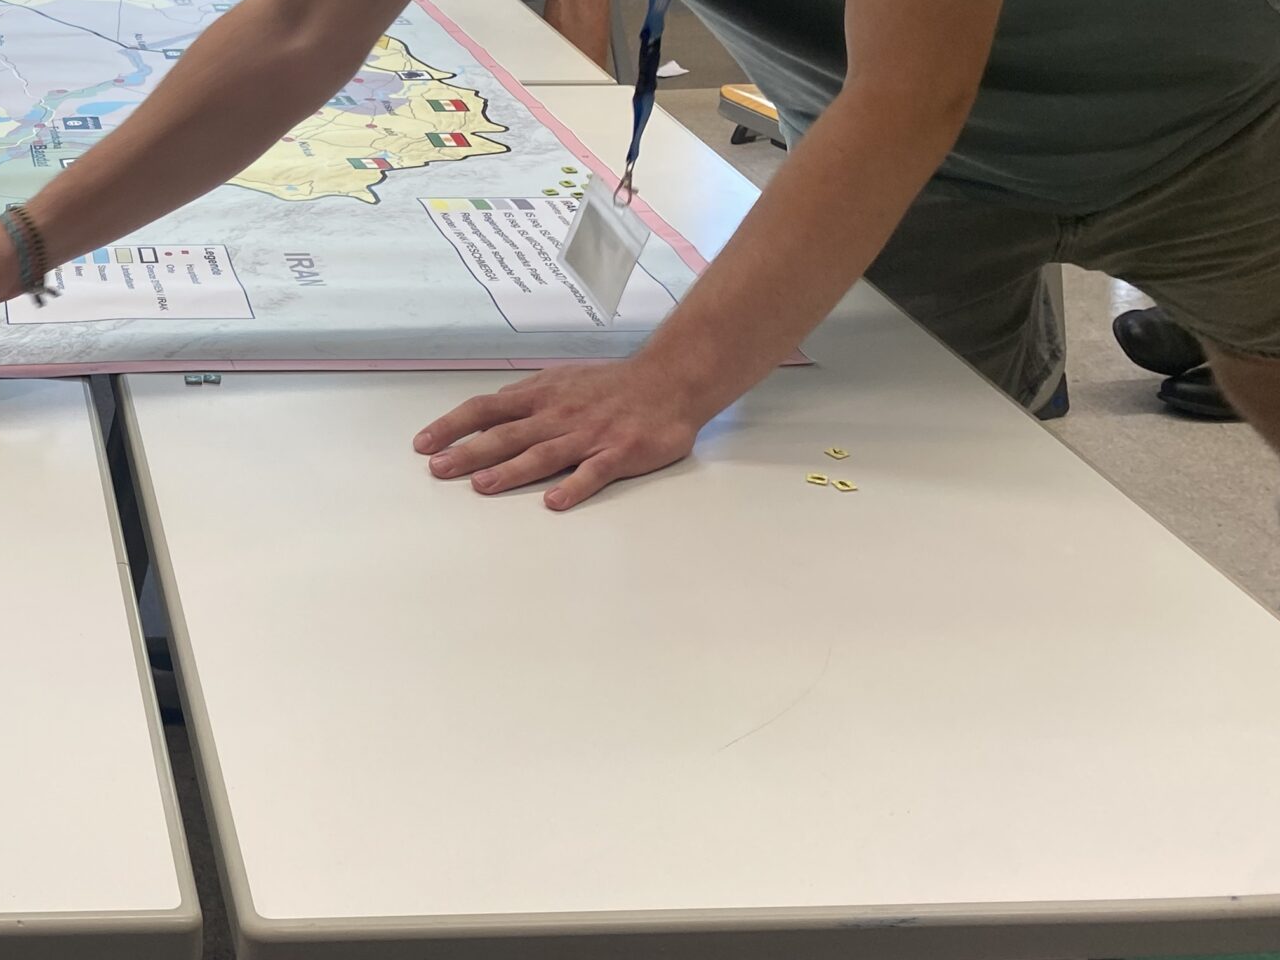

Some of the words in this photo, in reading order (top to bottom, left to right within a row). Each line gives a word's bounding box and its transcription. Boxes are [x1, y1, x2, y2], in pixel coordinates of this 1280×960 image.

[204, 247, 223, 276] Legende
[284, 253, 327, 287] IRAN
[157, 296, 169, 312] IRAK
